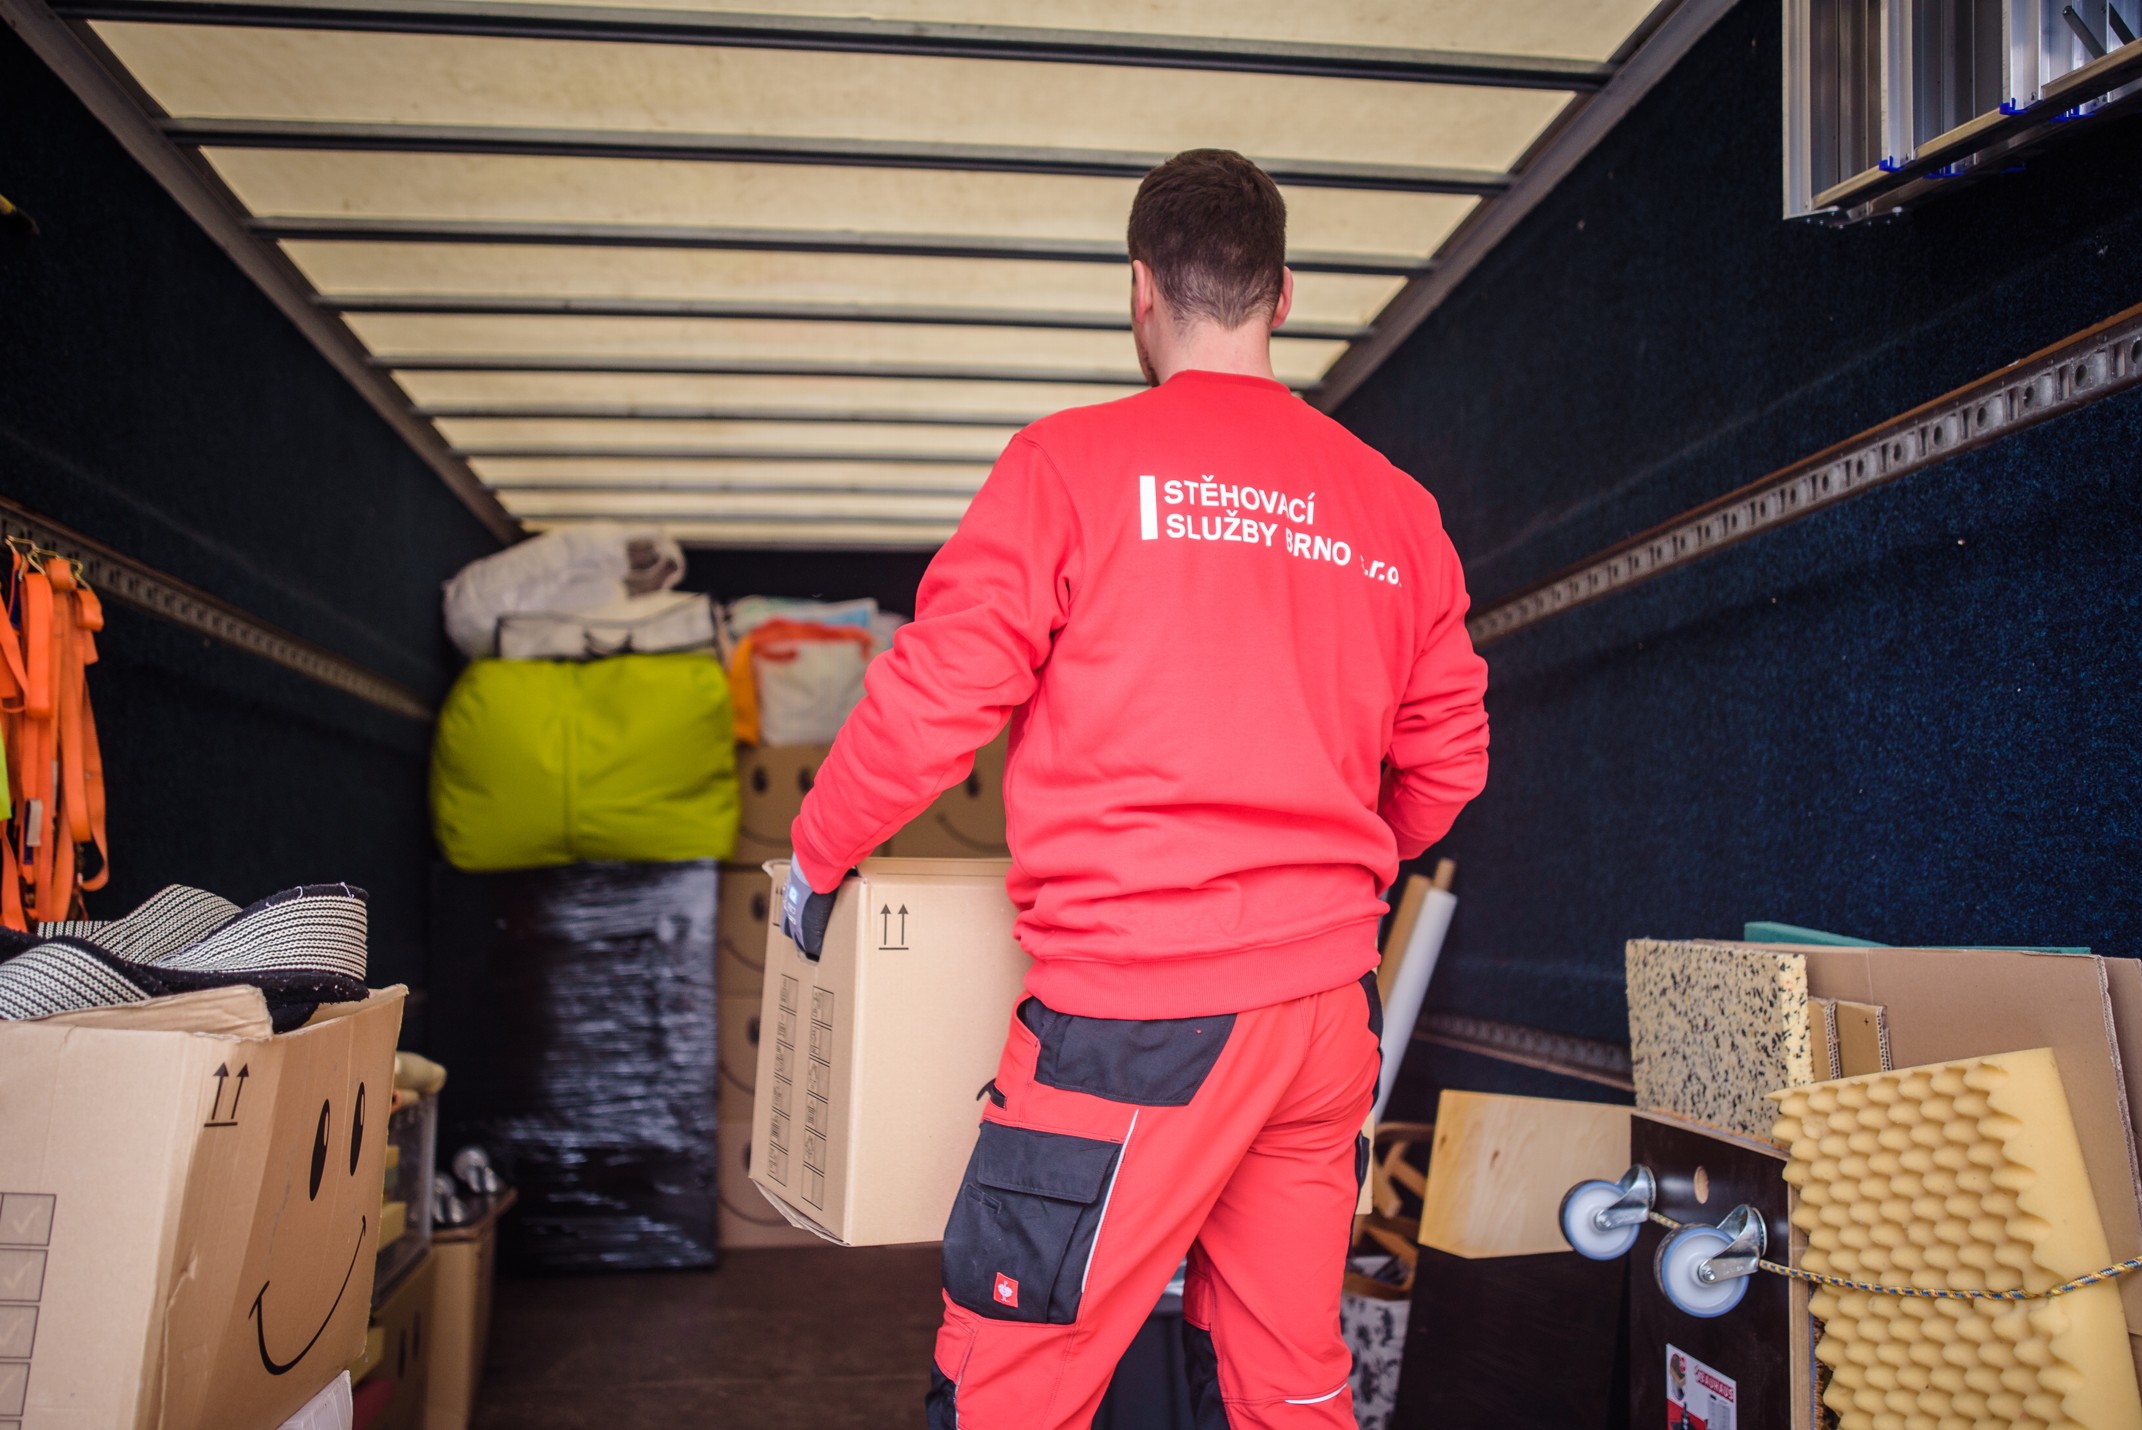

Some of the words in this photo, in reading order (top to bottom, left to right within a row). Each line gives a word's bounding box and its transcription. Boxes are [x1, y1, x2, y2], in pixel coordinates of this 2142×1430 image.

[1163, 474, 1315, 525] STĚHOVACÍ
[1166, 509, 1278, 547] SLUŽBY
[1285, 527, 1352, 567] BRNO
